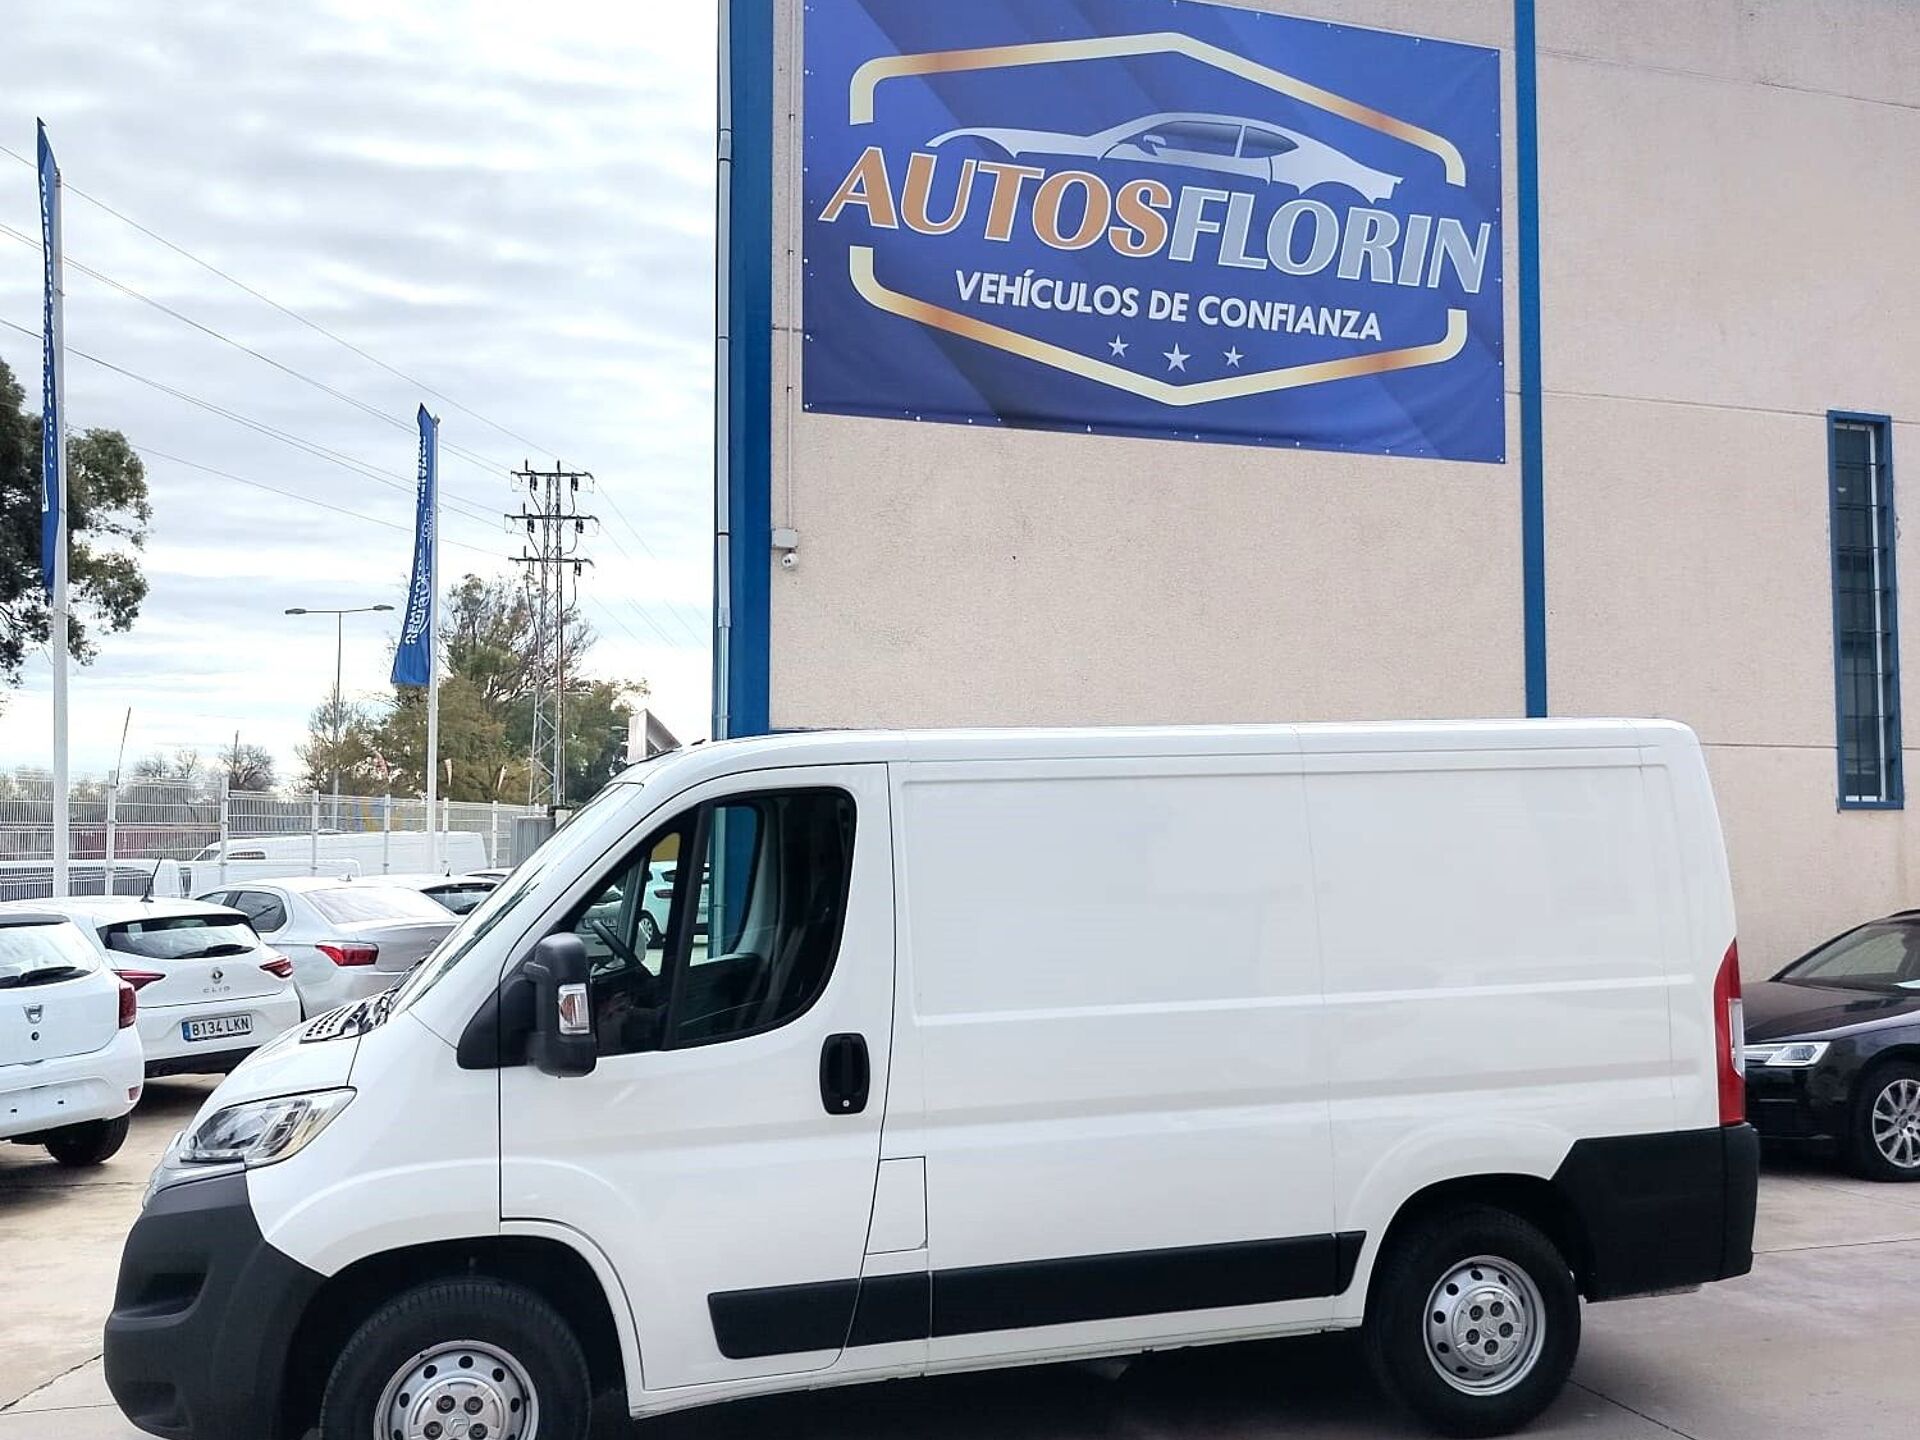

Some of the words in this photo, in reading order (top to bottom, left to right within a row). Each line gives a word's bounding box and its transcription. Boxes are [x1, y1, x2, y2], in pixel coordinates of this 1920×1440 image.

[818, 145, 1491, 295] AUTOSFLORIN
[955, 269, 1139, 317] VEHÍCULOS
[1148, 290, 1189, 322] DE
[1198, 295, 1382, 341] CONFIANZA
[192, 1021, 223, 1036] 8134
[226, 1017, 249, 1032] LKN
